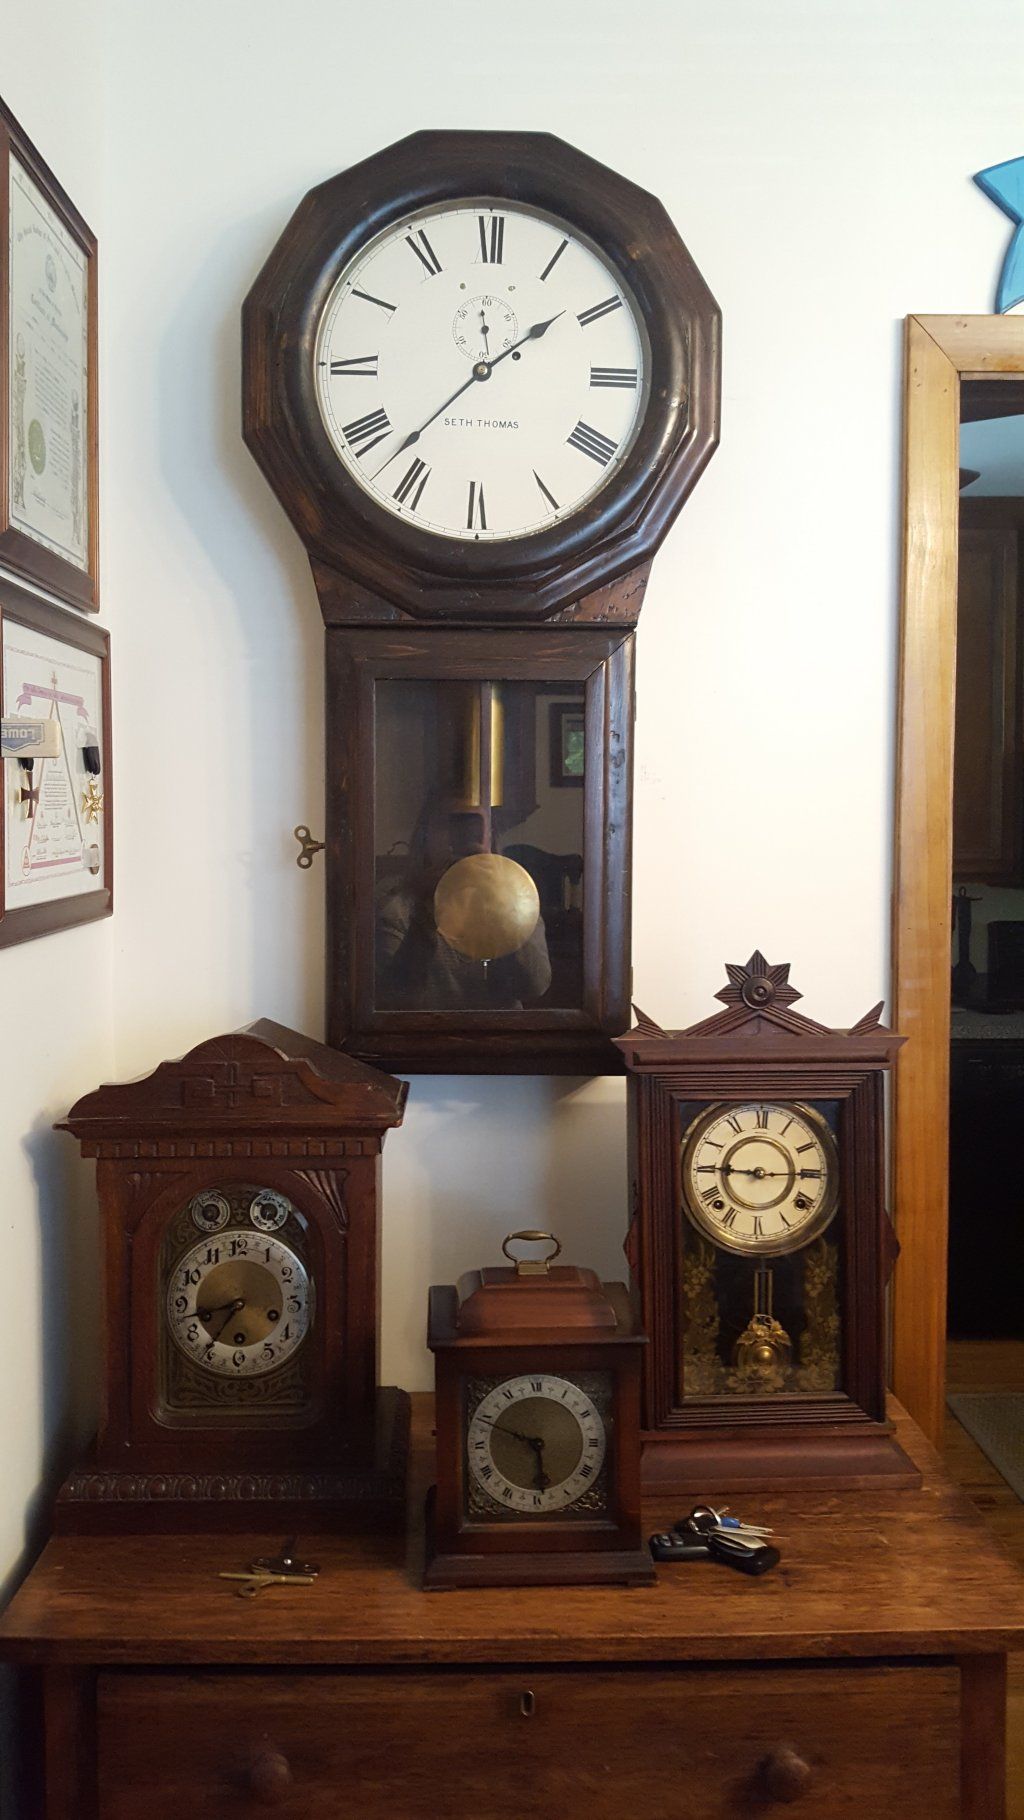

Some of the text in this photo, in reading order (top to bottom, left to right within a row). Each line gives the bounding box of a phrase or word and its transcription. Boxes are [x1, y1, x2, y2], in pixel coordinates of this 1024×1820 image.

[444, 418, 519, 429] SETH THOMAS
[203, 1247, 220, 1265] 11
[229, 1239, 248, 1257] 12
[182, 1268, 201, 1287] 10
[281, 1266, 294, 1284] 2
[175, 1296, 188, 1314] 9
[187, 1323, 200, 1342] 8
[232, 1350, 246, 1368] 6
[261, 1342, 275, 1361] 5
